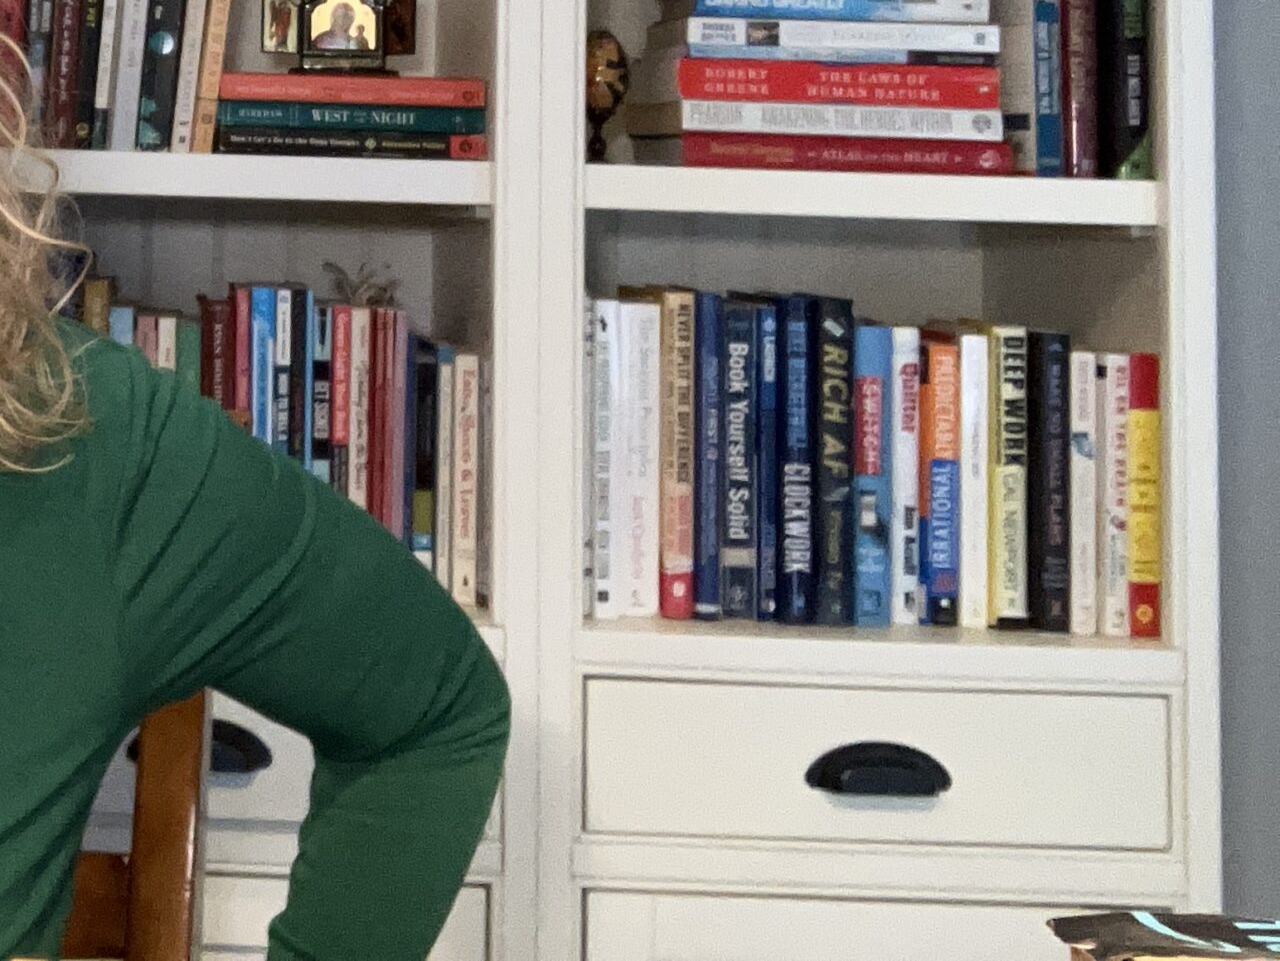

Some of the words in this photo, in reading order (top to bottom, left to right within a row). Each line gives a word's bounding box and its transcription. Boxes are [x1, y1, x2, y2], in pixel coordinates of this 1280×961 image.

[704, 67, 769, 81] ROBERT
[704, 82, 770, 97] GREENE
[806, 85, 870, 99] HUMAN
[874, 87, 942, 102] NATURE
[818, 70, 852, 84] THE
[857, 70, 901, 86] LAWS
[906, 72, 929, 86] OF
[311, 109, 349, 123] WEST
[370, 111, 416, 125] NIGHT
[820, 149, 863, 161] ATLAS
[903, 151, 948, 164] HEART
[214, 324, 224, 354] RYAN
[677, 303, 691, 343] NEVER
[677, 345, 691, 380] SPLIT
[727, 342, 750, 393] Book
[822, 343, 848, 424] RICH
[1003, 336, 1025, 391] DEEP
[1048, 364, 1063, 407] MAKE
[459, 369, 475, 413] Eats,
[677, 385, 691, 407] THE
[899, 361, 918, 433] Quitter
[934, 355, 954, 460] PREDICTABLY
[460, 414, 476, 465] Shoots
[677, 411, 691, 484] DIFFERENCE
[707, 408, 718, 445] FIRST
[728, 399, 750, 481] Yourself
[863, 382, 880, 465] SWITCH
[1003, 398, 1025, 466] WORK
[1049, 413, 1063, 435] NO
[1116, 420, 1128, 452] THE
[460, 469, 474, 483] &
[823, 431, 849, 479] AF
[1049, 438, 1063, 490] SMALL
[1002, 471, 1020, 503] CAL
[459, 488, 474, 540] Leaves
[727, 487, 750, 541] Solid
[783, 462, 811, 575] CLOCKWORK
[932, 464, 951, 569] IRRATIONAL
[1049, 494, 1063, 546] PLANS
[1002, 509, 1020, 592] NEWPORT
